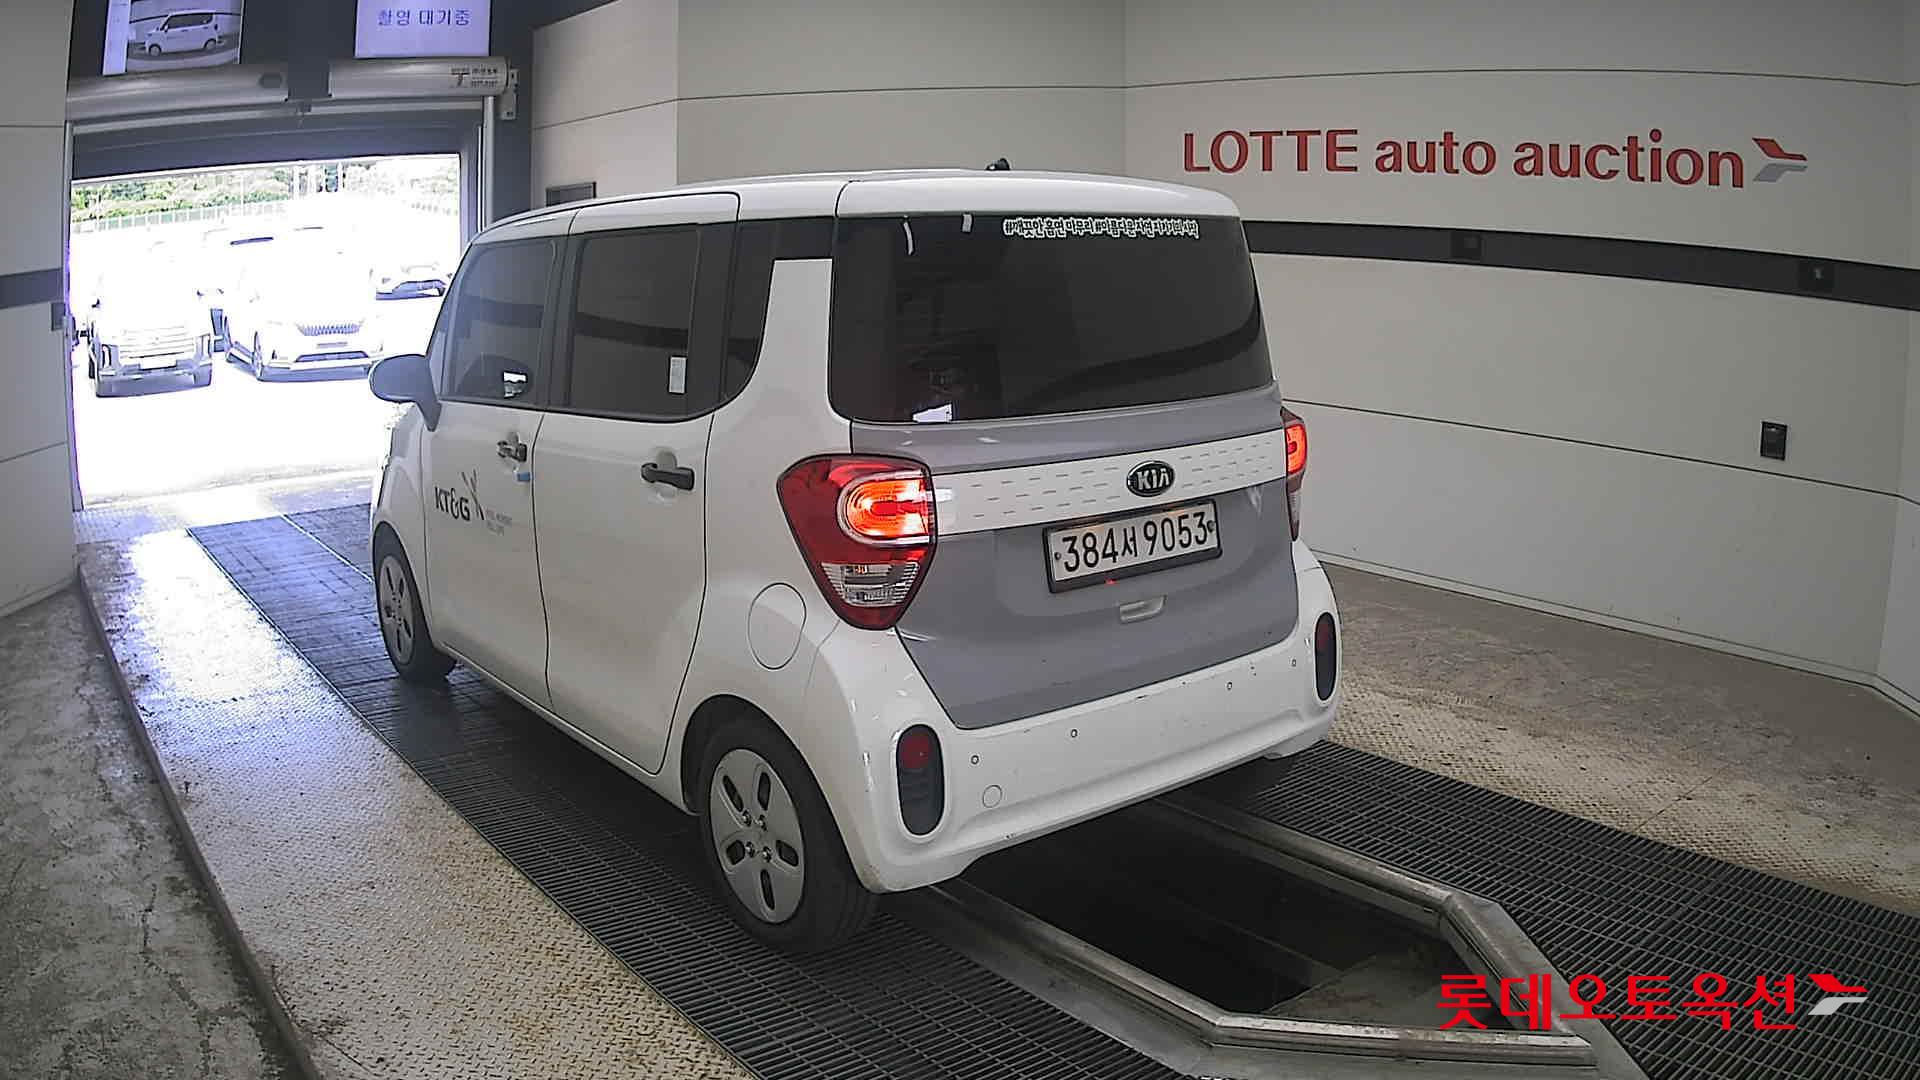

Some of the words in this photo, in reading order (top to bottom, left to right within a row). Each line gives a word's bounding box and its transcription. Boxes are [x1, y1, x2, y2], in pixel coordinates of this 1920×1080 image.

[378, 8, 410, 26] 촬영
[419, 8, 469, 26] 대기중
[1184, 129, 1358, 173] LOTTE
[1375, 131, 1496, 175] auto
[1513, 129, 1744, 188] auction
[1136, 468, 1170, 490] KIA
[434, 486, 471, 521] KT&G
[1062, 526, 1138, 572] 384서
[1143, 511, 1208, 555] 9053
